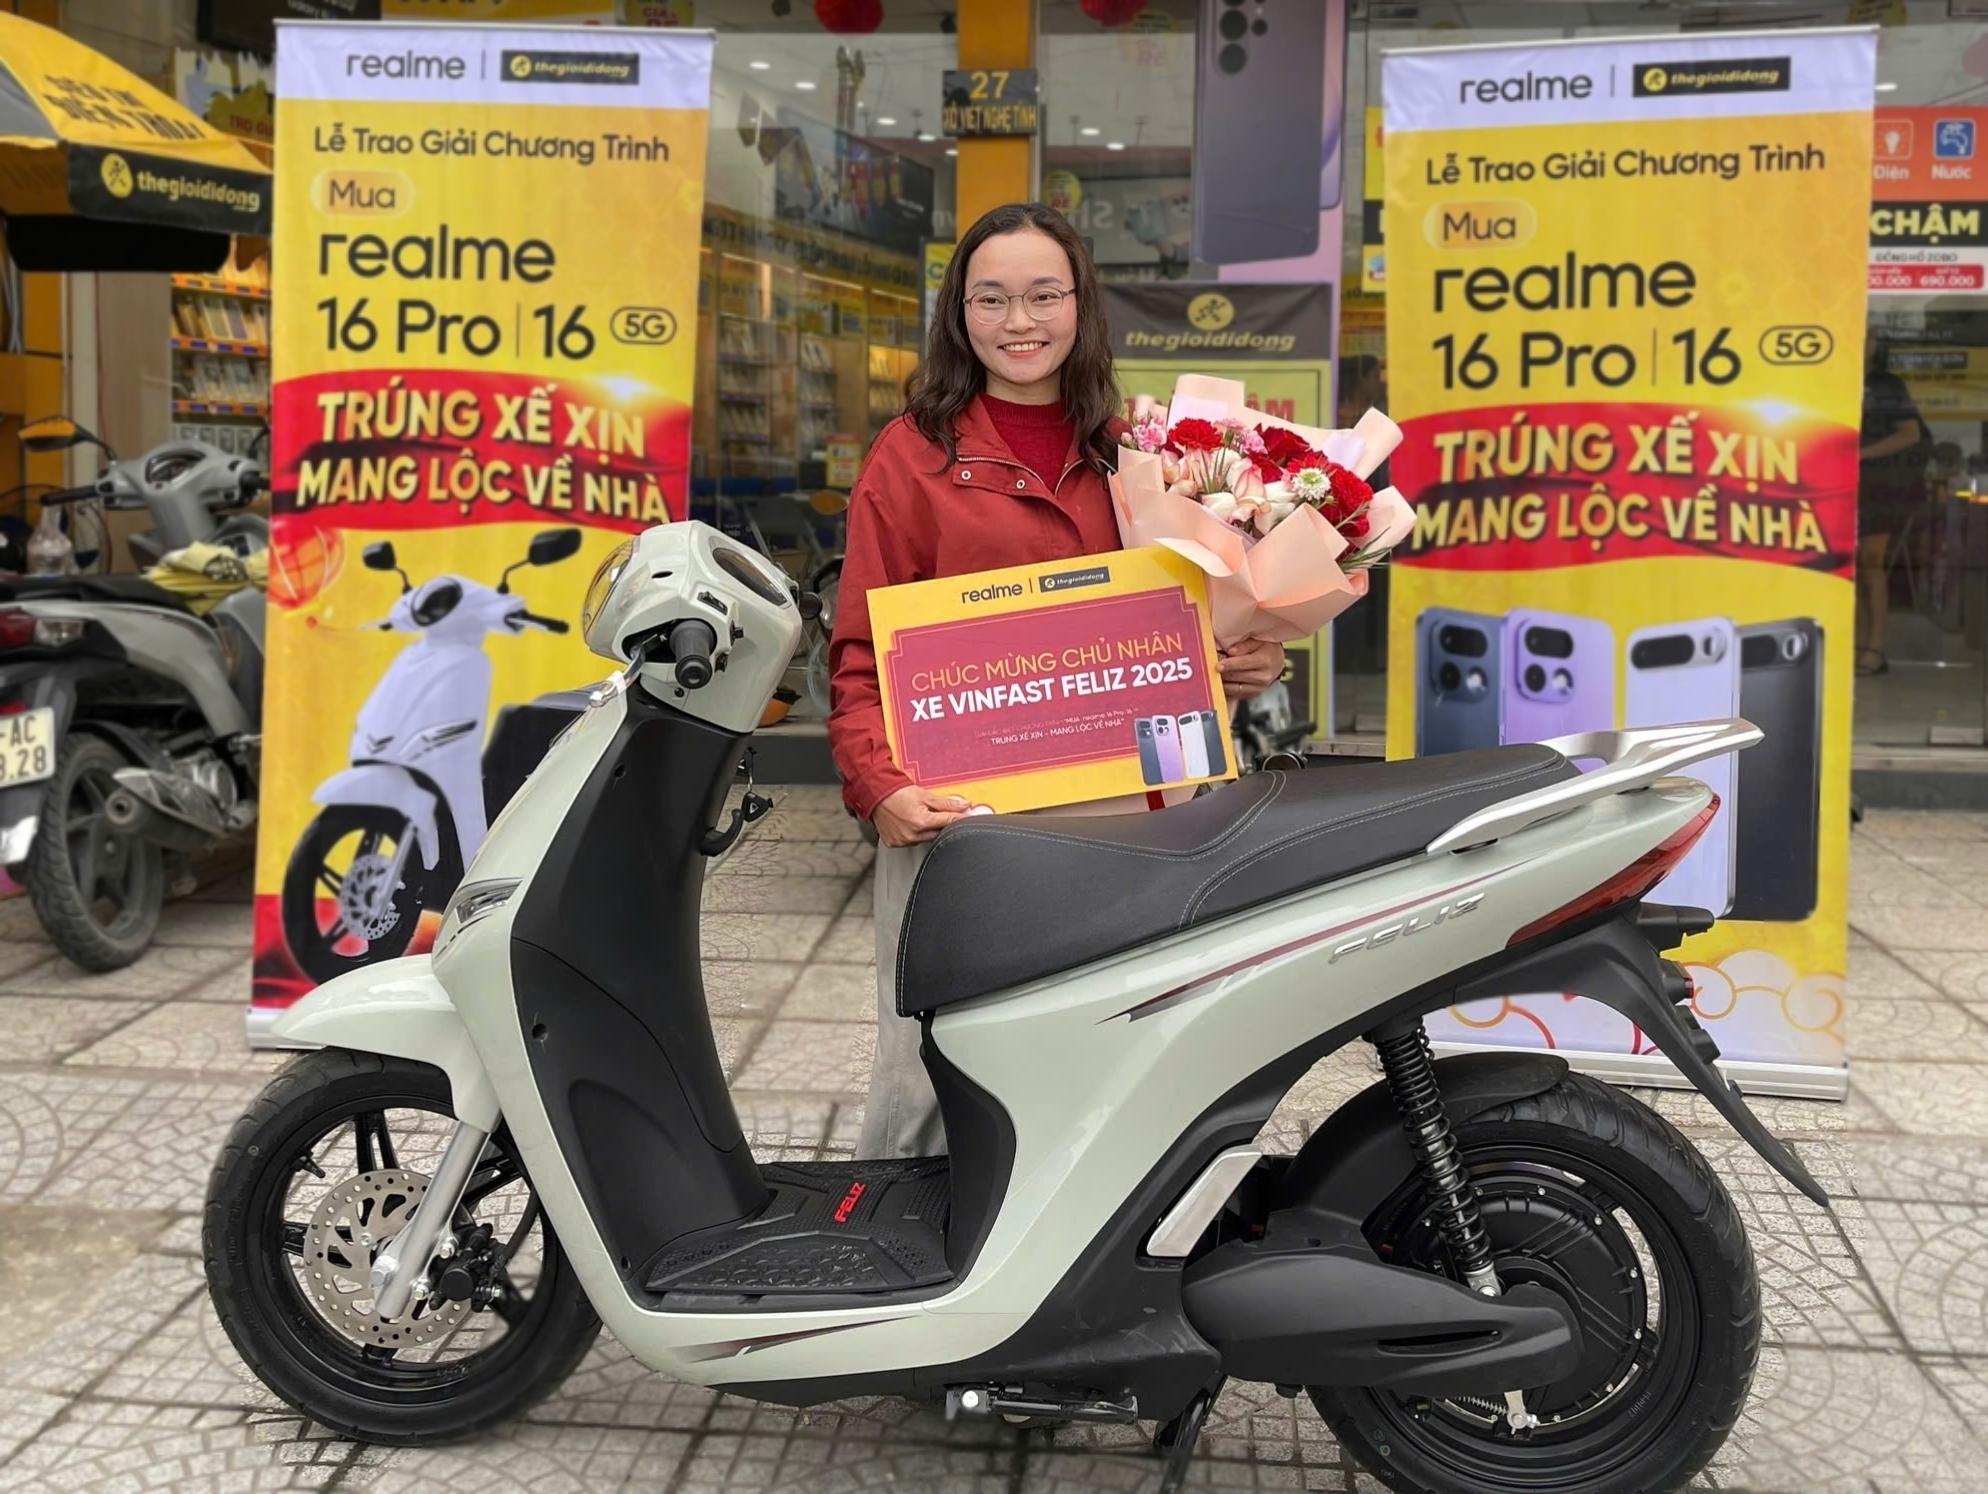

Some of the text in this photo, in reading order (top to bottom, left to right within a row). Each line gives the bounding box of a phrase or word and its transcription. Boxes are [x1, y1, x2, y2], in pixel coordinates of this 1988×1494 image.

[346, 51, 465, 79] realme
[534, 60, 631, 78] thegioididong
[969, 71, 1009, 99] 27
[1670, 68, 1780, 87] thegioididong
[1460, 72, 1593, 104] realme
[314, 122, 670, 166] Lễ Trao Giải Chương Trình
[1426, 142, 1826, 185] Lễ Trao Giải Chương Trình
[137, 170, 261, 212] thegioididong
[328, 180, 396, 209] Mua
[1442, 211, 1517, 242] Mua
[1870, 203, 1981, 244] CHẬM
[319, 224, 556, 283] realme
[1433, 251, 1696, 313] realme
[317, 297, 667, 360] 16 Pro 16 5G
[1124, 330, 1296, 352] thegioididong
[1432, 326, 1822, 390] 16 Pro 16 5G
[317, 375, 646, 466] TRÚNG XẾ XỊN
[1433, 410, 1799, 494] TRÚNG XẾ XỊN
[296, 447, 671, 524] MANG LỘC VỀ NHÀ
[1411, 483, 1828, 554] MANG LỘC VỀ NHÀ
[961, 583, 1023, 604] realme
[911, 630, 1183, 692] CHÚC MỪNG CHỦ NHÂN
[910, 656, 1193, 722] XE VINFAST FELIZ 2025
[1327, 891, 1487, 965] FELIZ
